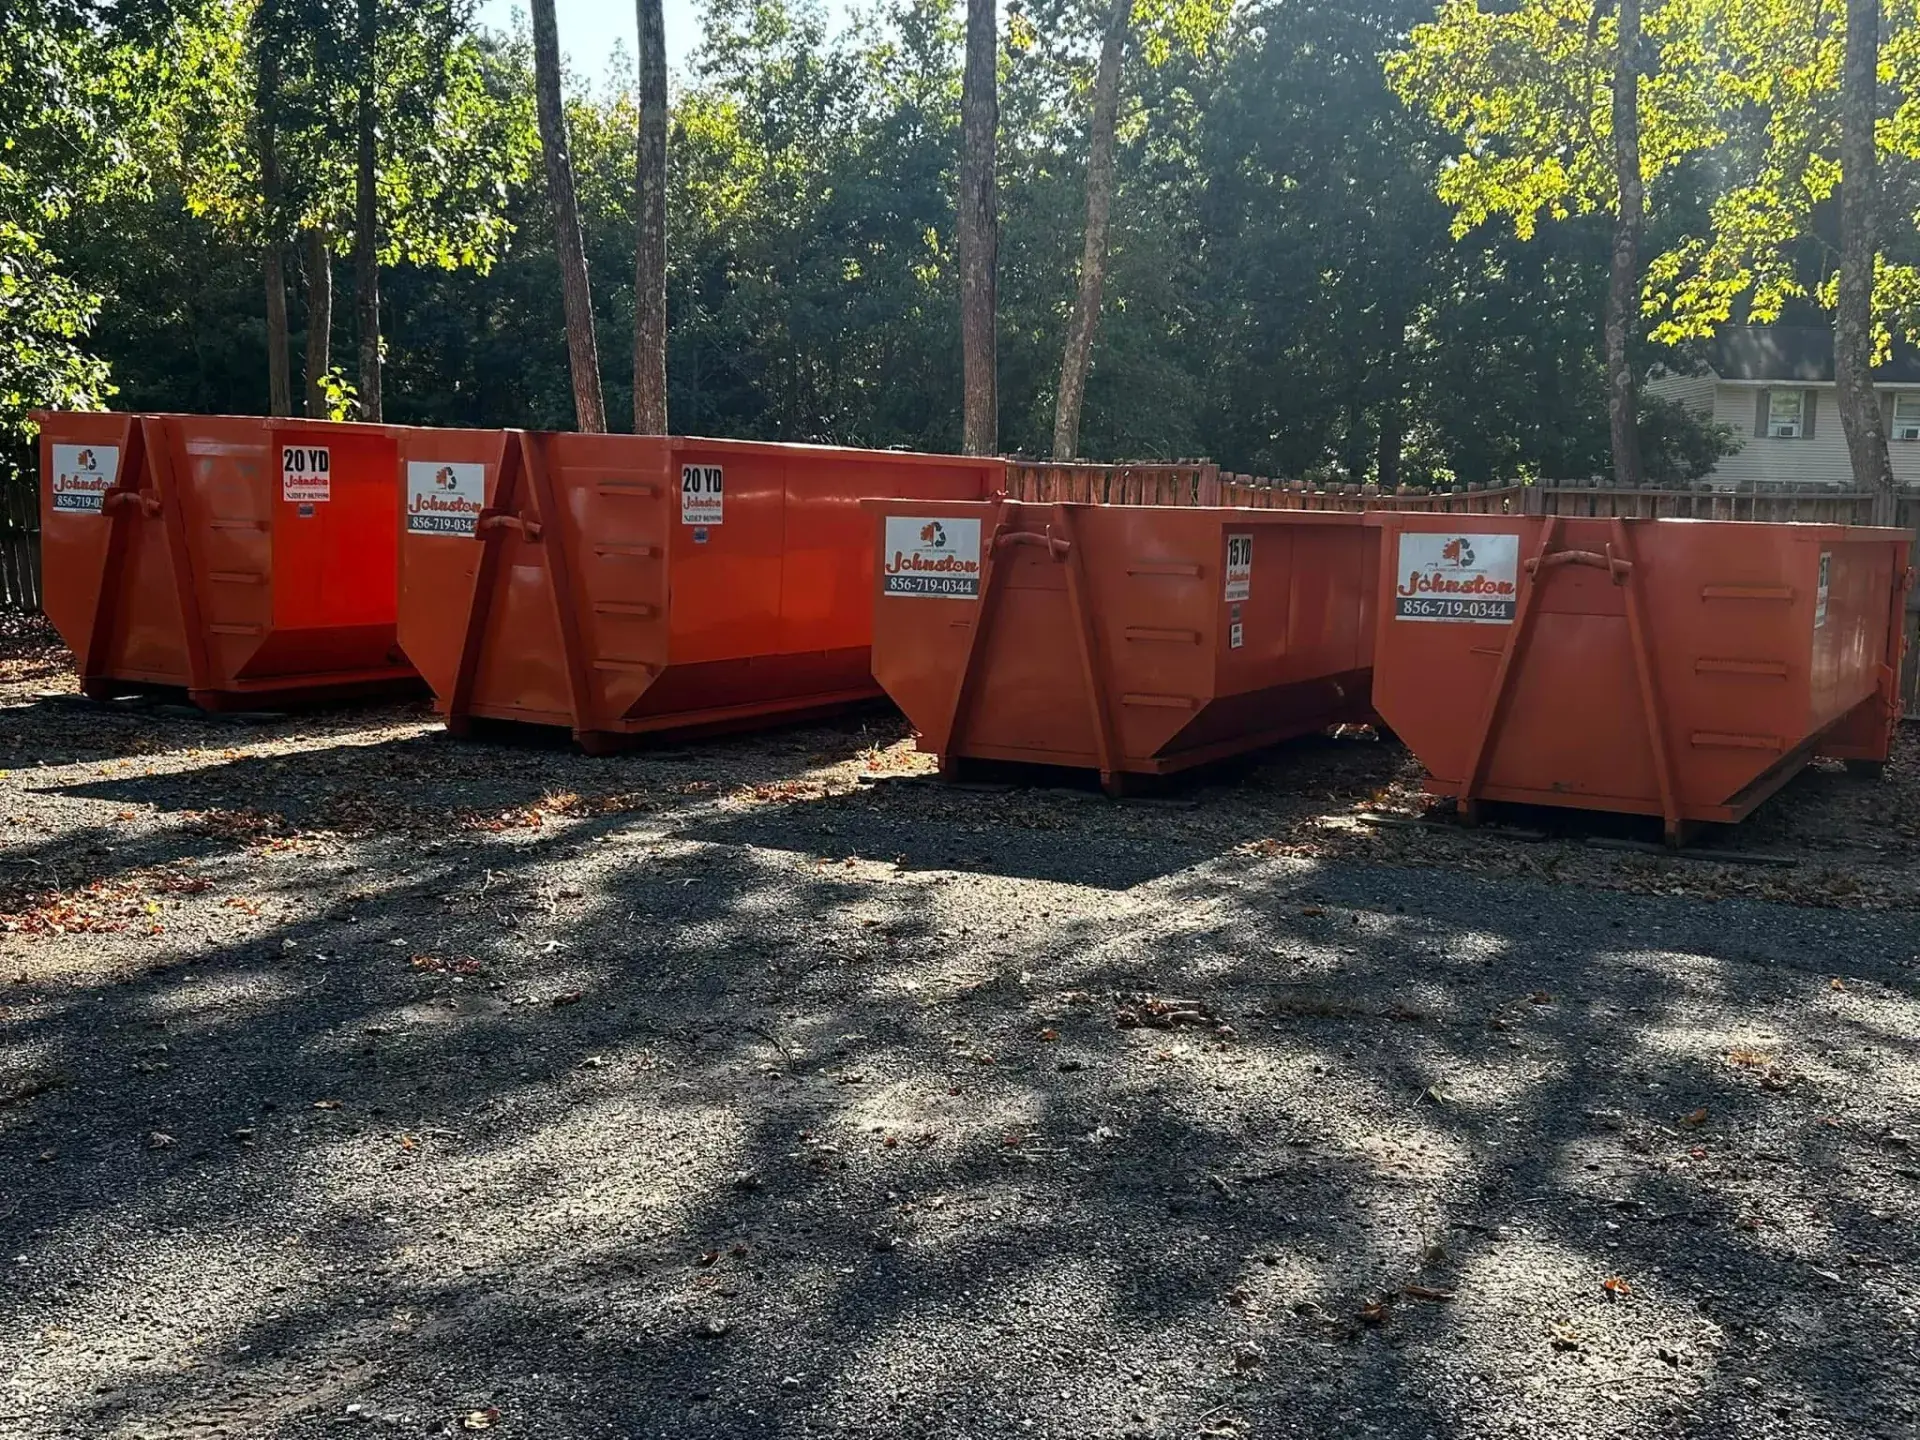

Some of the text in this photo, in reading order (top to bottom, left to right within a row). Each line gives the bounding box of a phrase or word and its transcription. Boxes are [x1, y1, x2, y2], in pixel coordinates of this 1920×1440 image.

[284, 448, 329, 472] 20 YD
[683, 467, 722, 493] 20 YD
[409, 493, 482, 514] Johnston
[412, 516, 477, 531] 856-719-034
[884, 551, 979, 574] Johnston
[1229, 538, 1251, 566] 15 YD
[890, 577, 972, 593] 856-719-0344
[1398, 571, 1515, 597] Johnston
[1403, 600, 1507, 617] 856-719-0344
